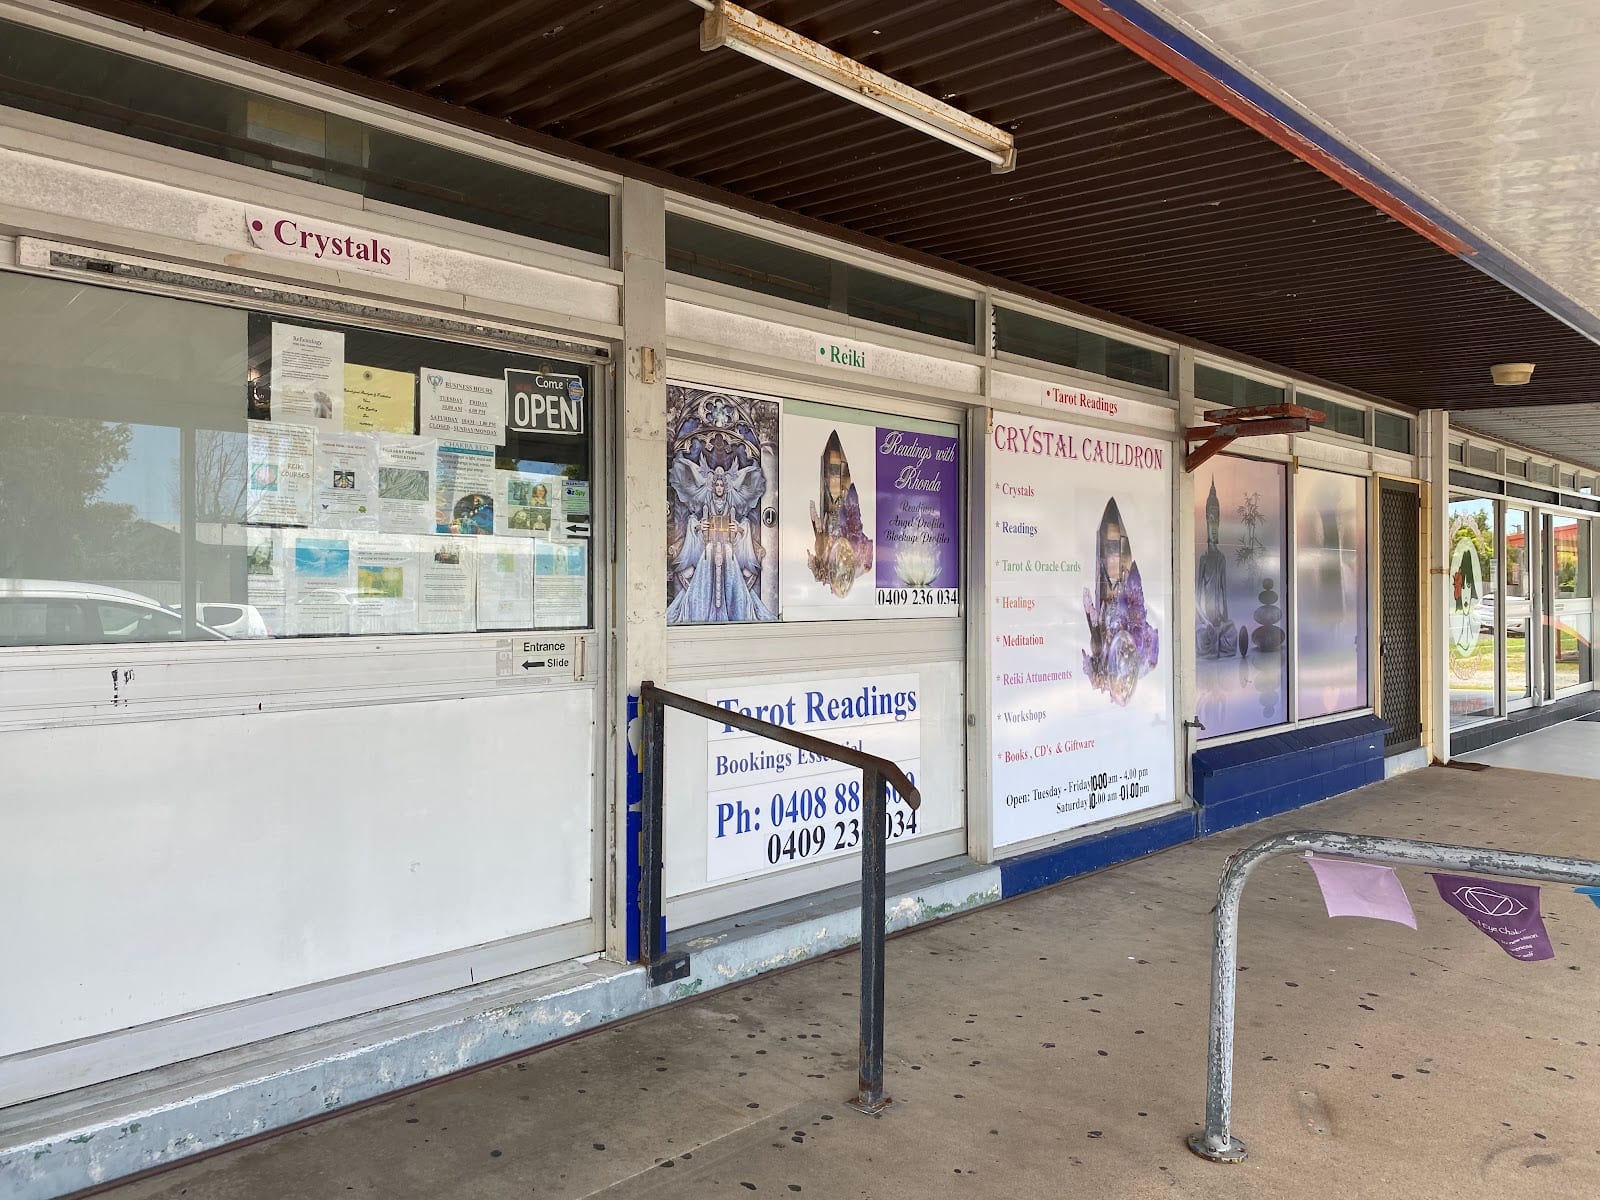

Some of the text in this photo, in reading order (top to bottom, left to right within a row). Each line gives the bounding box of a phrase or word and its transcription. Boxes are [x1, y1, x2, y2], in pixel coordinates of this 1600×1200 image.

[274, 220, 391, 265] Crystals
[830, 346, 866, 368] Reiki
[445, 382, 493, 394] BUSINESS HOURS
[535, 375, 563, 390] Come
[439, 396, 463, 404] TUESDAY
[1052, 388, 1118, 415] Tarot Readings
[430, 415, 459, 423] SATURDAY
[514, 392, 578, 430] OPEN
[429, 423, 450, 431] CLOSED
[880, 431, 956, 468] Readings with
[994, 424, 1163, 470] CRYSTAL CAULDRON
[894, 465, 942, 492] Rhonda
[1002, 483, 1035, 499] Crystals
[889, 515, 945, 531] Angel Profiles
[1002, 521, 1038, 537] Readings
[884, 529, 950, 544] Blockage Profiles
[1002, 559, 1081, 573] Tarot & Oracle Cards
[878, 589, 959, 605] 0409 236 034
[1002, 596, 1036, 611] Healings
[523, 642, 565, 652] Entrance
[1002, 634, 1044, 647] Meditation
[547, 658, 569, 668] Slide
[1003, 669, 1072, 686] Reiki Attunements
[805, 685, 917, 722] Readings
[1003, 709, 1047, 724] Workshops
[1034, 744, 1052, 758] CD's
[1056, 743, 1062, 754] &
[1064, 738, 1095, 753] Giftware
[716, 750, 792, 776] Bookings
[1006, 793, 1030, 808] Open:
[1032, 785, 1061, 801] Tuesday
[1068, 779, 1091, 793] Friday
[1108, 775, 1118, 784] am
[1138, 767, 1149, 781] pm
[1056, 798, 1088, 814] Saturday
[1107, 792, 1118, 802] am
[1139, 783, 1150, 798] pm
[715, 800, 761, 838] Ph:
[770, 786, 827, 827] 0408
[834, 780, 860, 815] 88
[767, 825, 826, 865] 0409
[833, 818, 860, 850] 23
